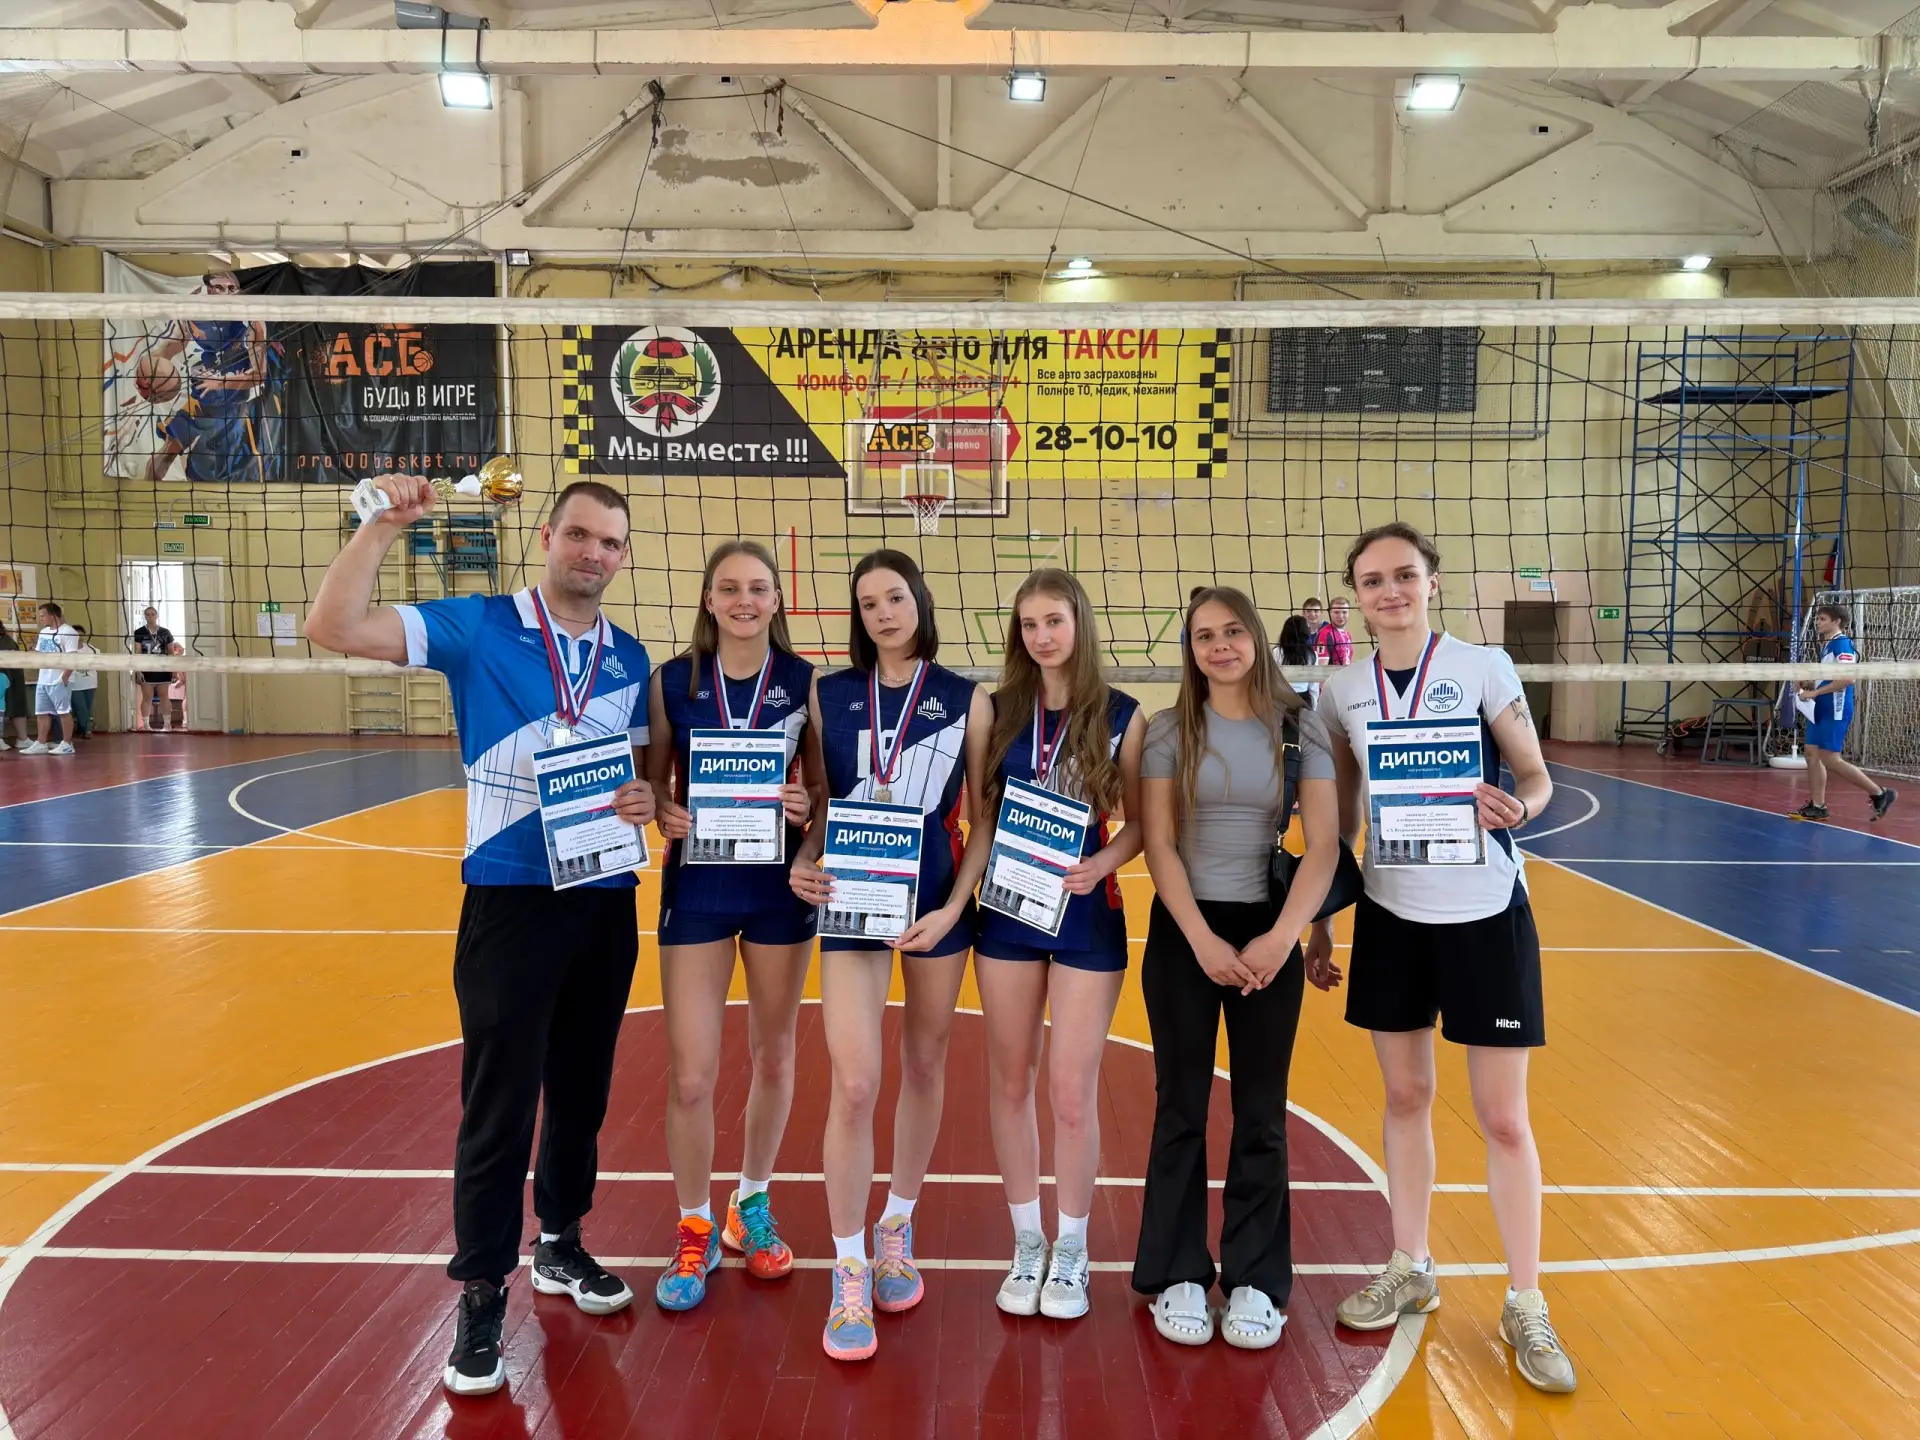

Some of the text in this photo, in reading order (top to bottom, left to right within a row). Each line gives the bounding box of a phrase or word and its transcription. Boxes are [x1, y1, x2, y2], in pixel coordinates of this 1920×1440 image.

[324, 331, 434, 377] АСБ
[776, 328, 902, 364] АРЕНДА
[1059, 329, 1158, 360] ТАКСИ
[797, 374, 891, 396] комфот
[1037, 369, 1157, 381] Все авто застрахованы
[433, 384, 476, 407] ИГРЕ
[1037, 385, 1176, 397] Полное ТО, медик, механик
[867, 423, 935, 452] АСБ
[1035, 425, 1178, 451] 28-10-10
[608, 436, 808, 463] Мы вместе !!!
[700, 758, 776, 774] ДИПЛОМ
[1380, 750, 1470, 769] ДИПЛОМ
[549, 763, 625, 795] ДИПЛОМ
[1007, 808, 1076, 843] ДИПЛОМ
[835, 829, 912, 848] ДИПЛОМ
[1495, 1018, 1521, 1029] Hitch
